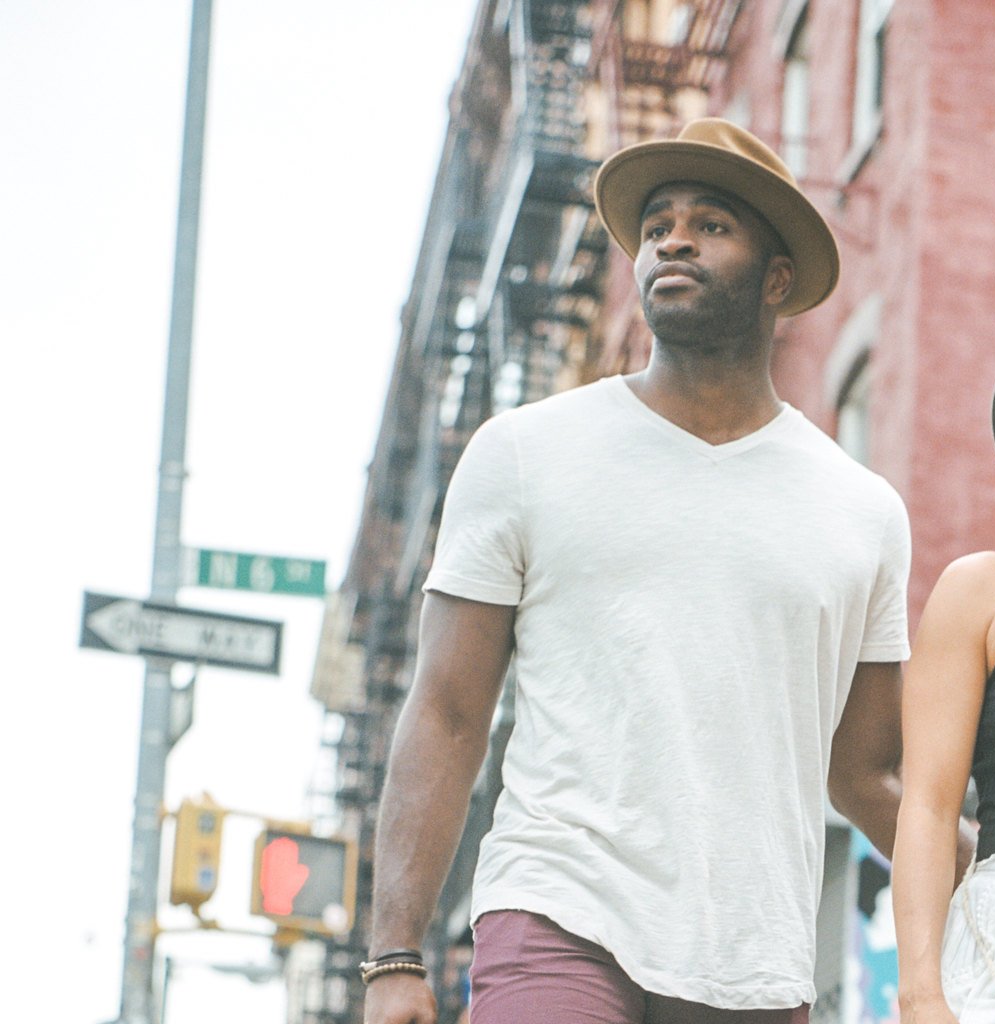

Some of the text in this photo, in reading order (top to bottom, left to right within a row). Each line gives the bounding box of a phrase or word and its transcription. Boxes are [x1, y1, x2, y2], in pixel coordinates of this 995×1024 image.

[208, 554, 237, 587] N
[251, 557, 275, 591] 6
[110, 611, 264, 653] ONE WAY
